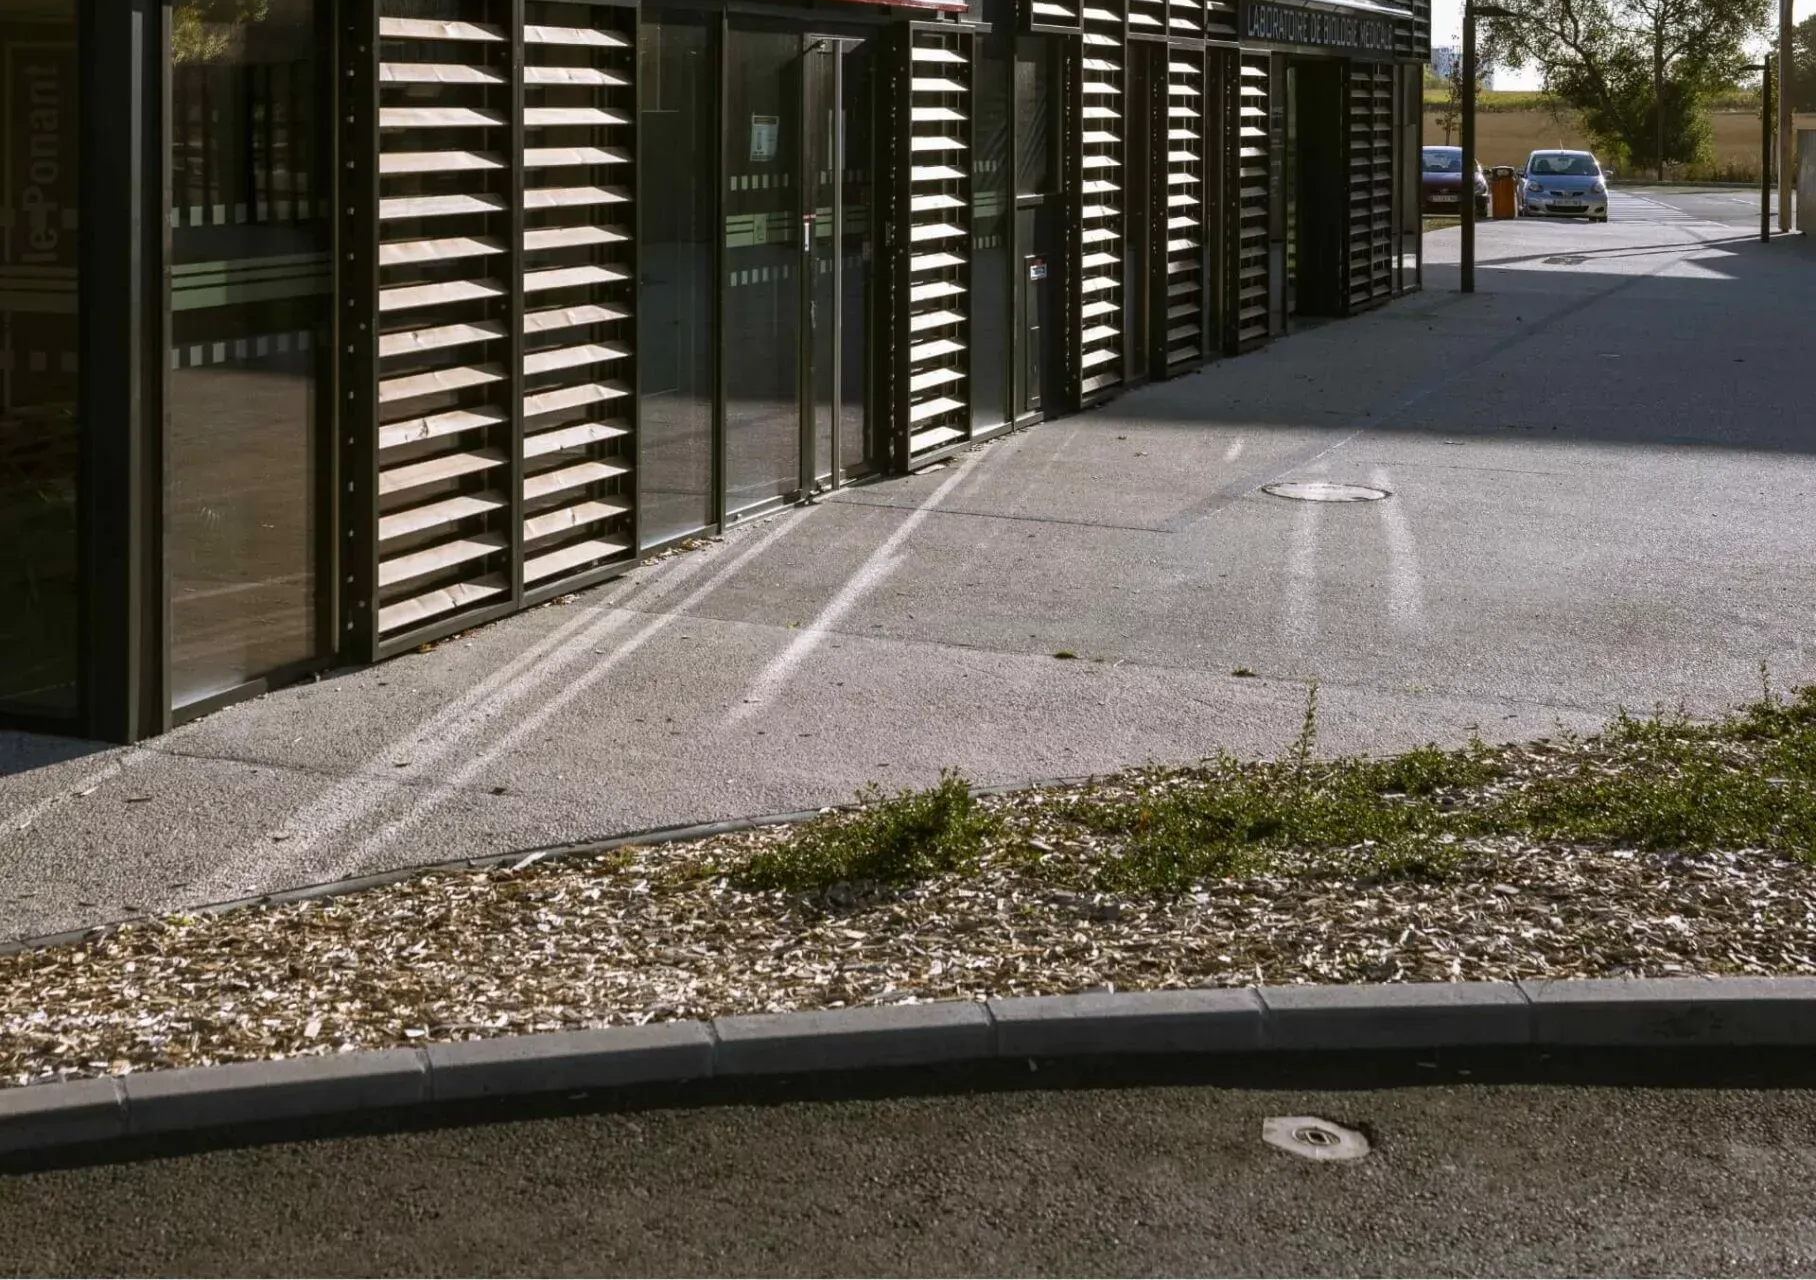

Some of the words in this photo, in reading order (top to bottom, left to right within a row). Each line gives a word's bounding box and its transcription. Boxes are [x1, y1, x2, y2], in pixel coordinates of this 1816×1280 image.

[1248, 3, 1308, 43] LABORATOIRE
[1310, 12, 1321, 44] DE
[21, 62, 59, 212] Ponant
[21, 228, 59, 263] le
